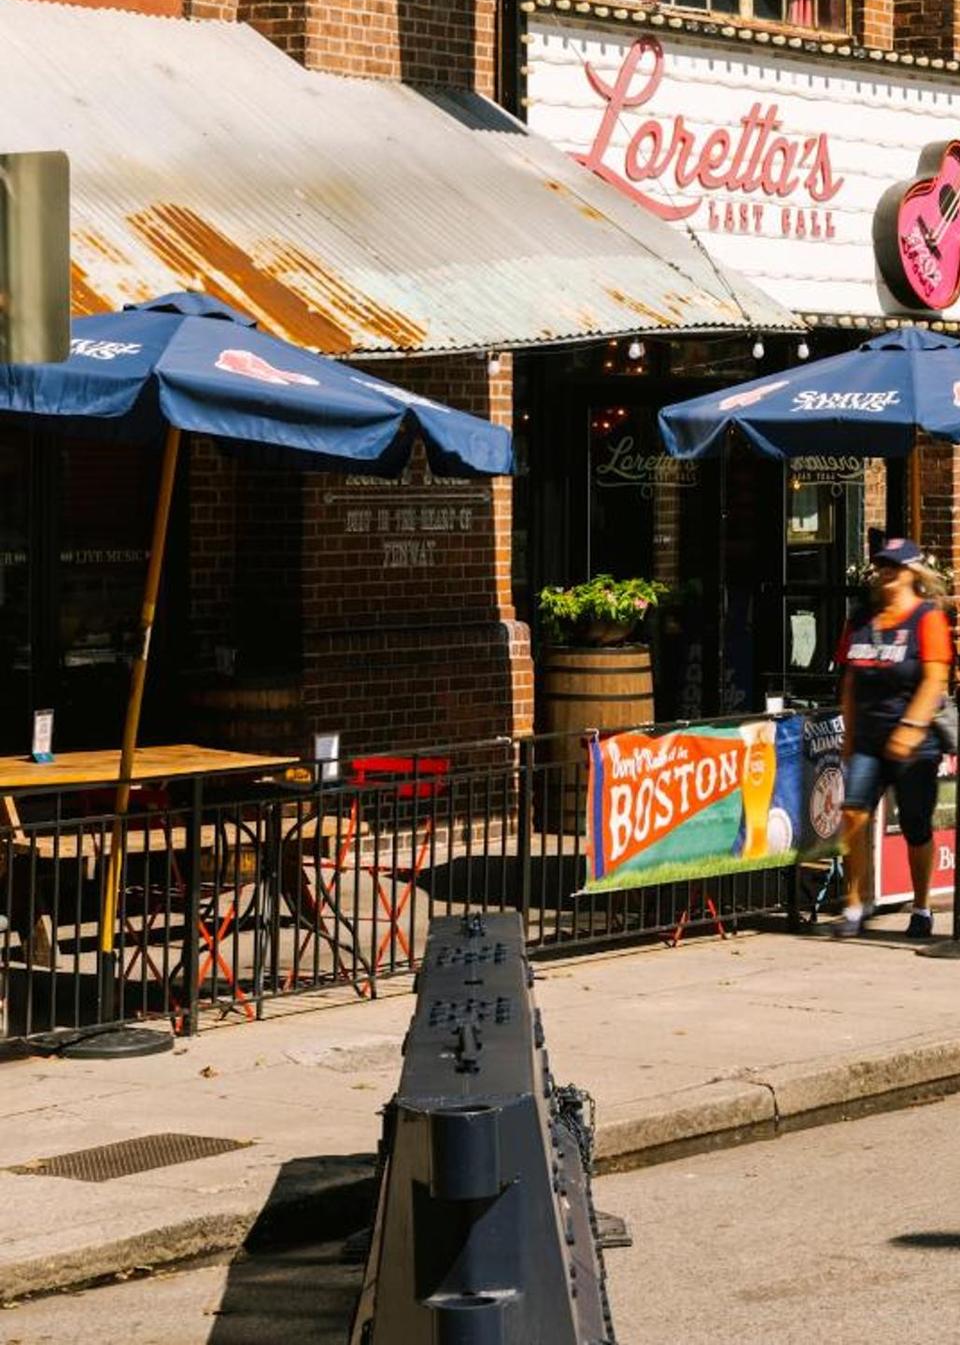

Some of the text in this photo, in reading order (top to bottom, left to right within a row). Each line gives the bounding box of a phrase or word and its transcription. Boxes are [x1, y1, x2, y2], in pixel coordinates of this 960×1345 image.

[568, 35, 845, 221] Loretta's
[708, 200, 836, 238] LAST CALL
[793, 391, 900, 406] SAMUEL
[609, 750, 739, 861] BOSTON
